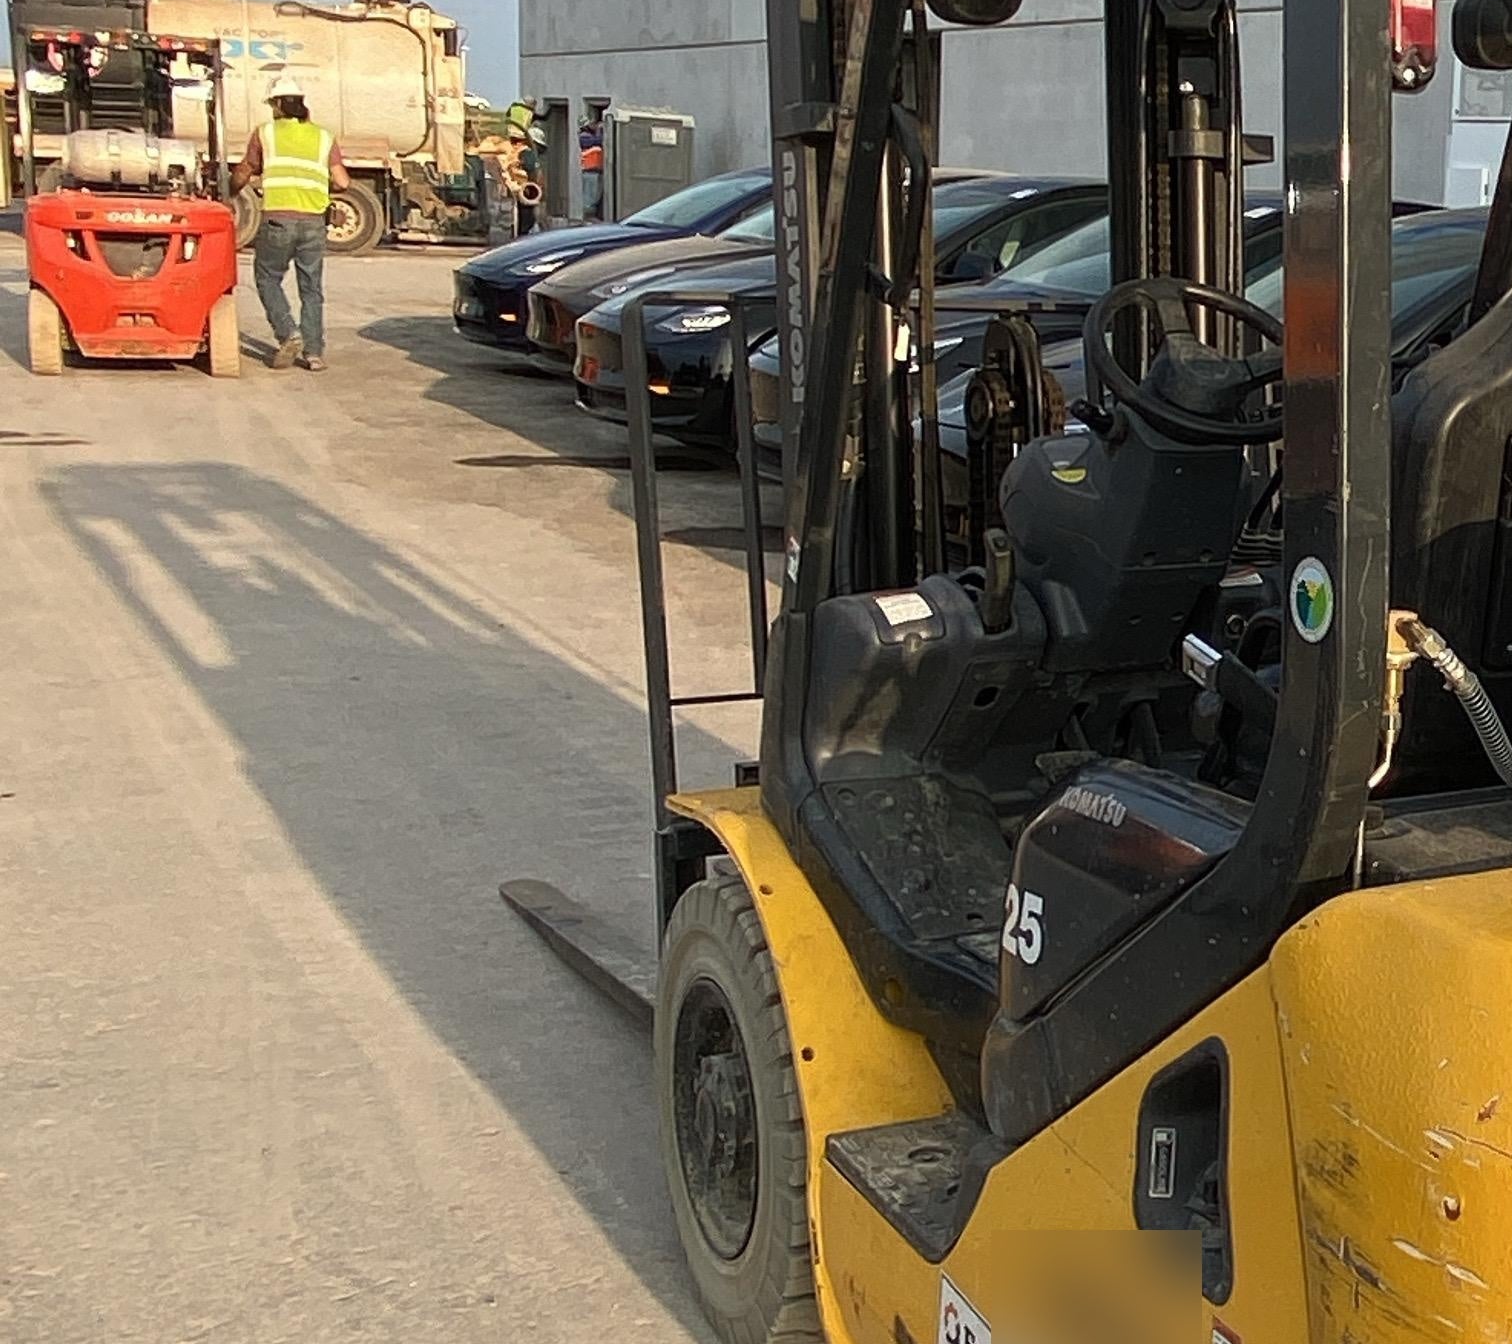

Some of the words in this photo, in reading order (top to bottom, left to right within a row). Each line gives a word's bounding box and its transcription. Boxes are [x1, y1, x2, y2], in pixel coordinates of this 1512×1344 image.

[781, 149, 806, 404] KOMATSU
[1058, 785, 1128, 828] KOMATSU
[1001, 883, 1045, 966] 25
